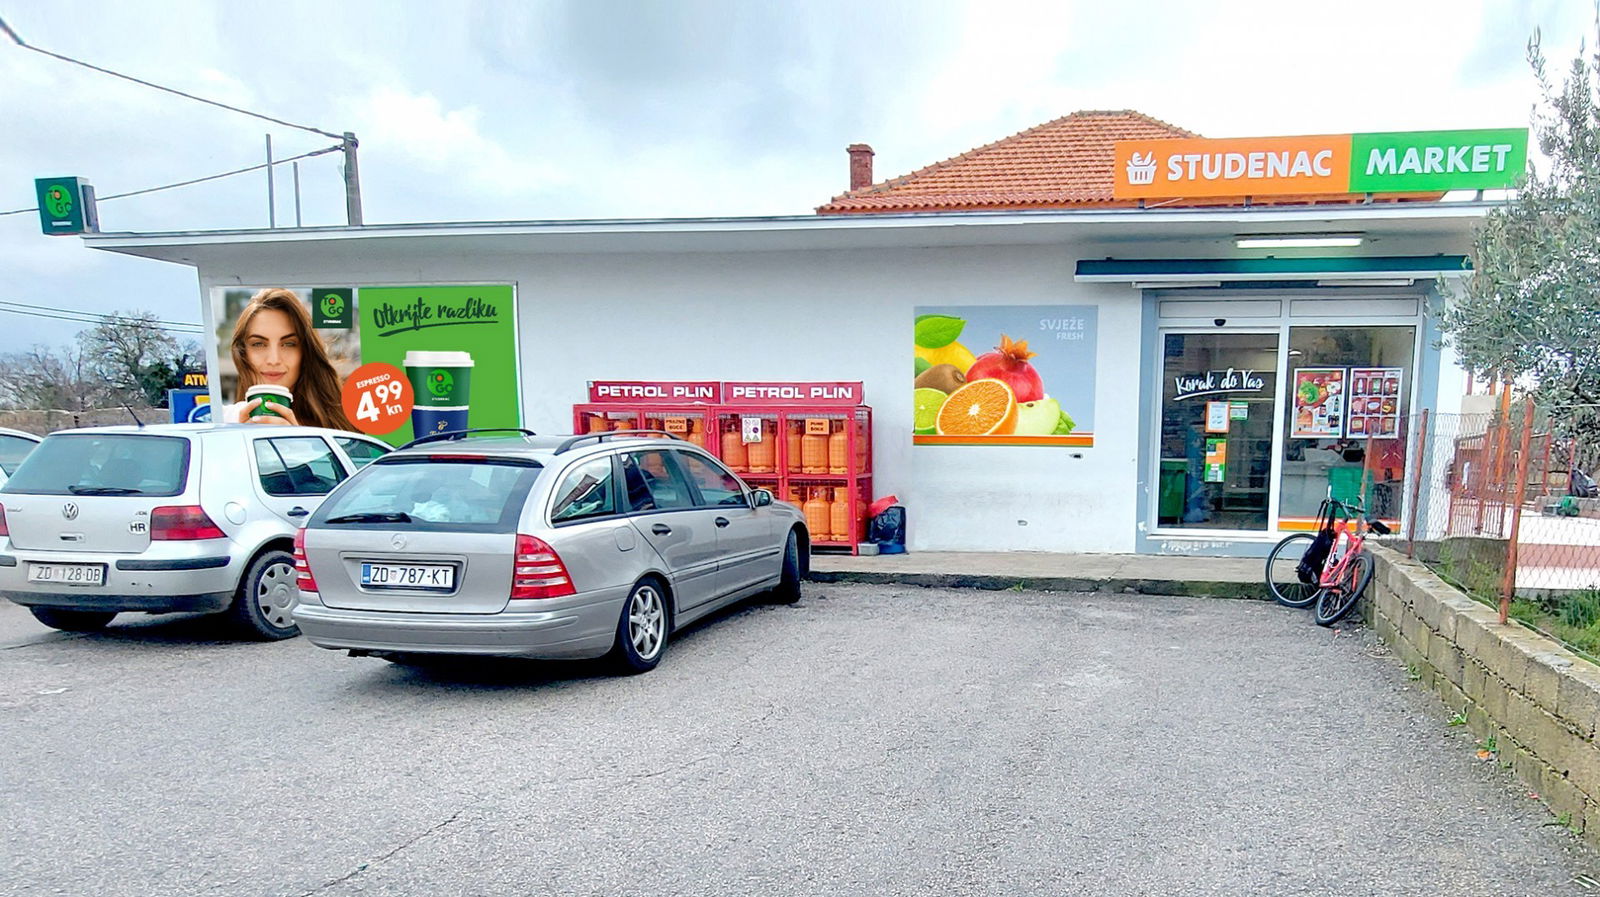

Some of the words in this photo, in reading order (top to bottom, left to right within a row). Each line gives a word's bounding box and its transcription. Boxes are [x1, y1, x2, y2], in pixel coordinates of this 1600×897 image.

[1167, 149, 1332, 180] STUDENAC
[1366, 144, 1512, 176] MARKET
[320, 296, 337, 306] TO
[328, 306, 344, 315] GO
[373, 296, 432, 331] Otkrijte
[437, 297, 498, 319] razliku
[1039, 316, 1085, 331] SVJEŽE
[1056, 331, 1084, 341] FRESH
[355, 373, 391, 389] ESPRESSO
[430, 373, 445, 384] TO
[1175, 371, 1216, 395] Korak
[1221, 367, 1237, 389] do
[1241, 369, 1265, 389] Vas
[435, 384, 454, 394] GO
[597, 385, 668, 398] PETROL
[673, 386, 714, 398] PLIN
[732, 386, 805, 399] PETROL
[810, 387, 853, 399] PLIN
[386, 403, 403, 416] kn
[130, 522, 146, 532] HR
[36, 566, 52, 580] ZD
[372, 566, 389, 582] ZD
[399, 567, 450, 585] 787-KT
